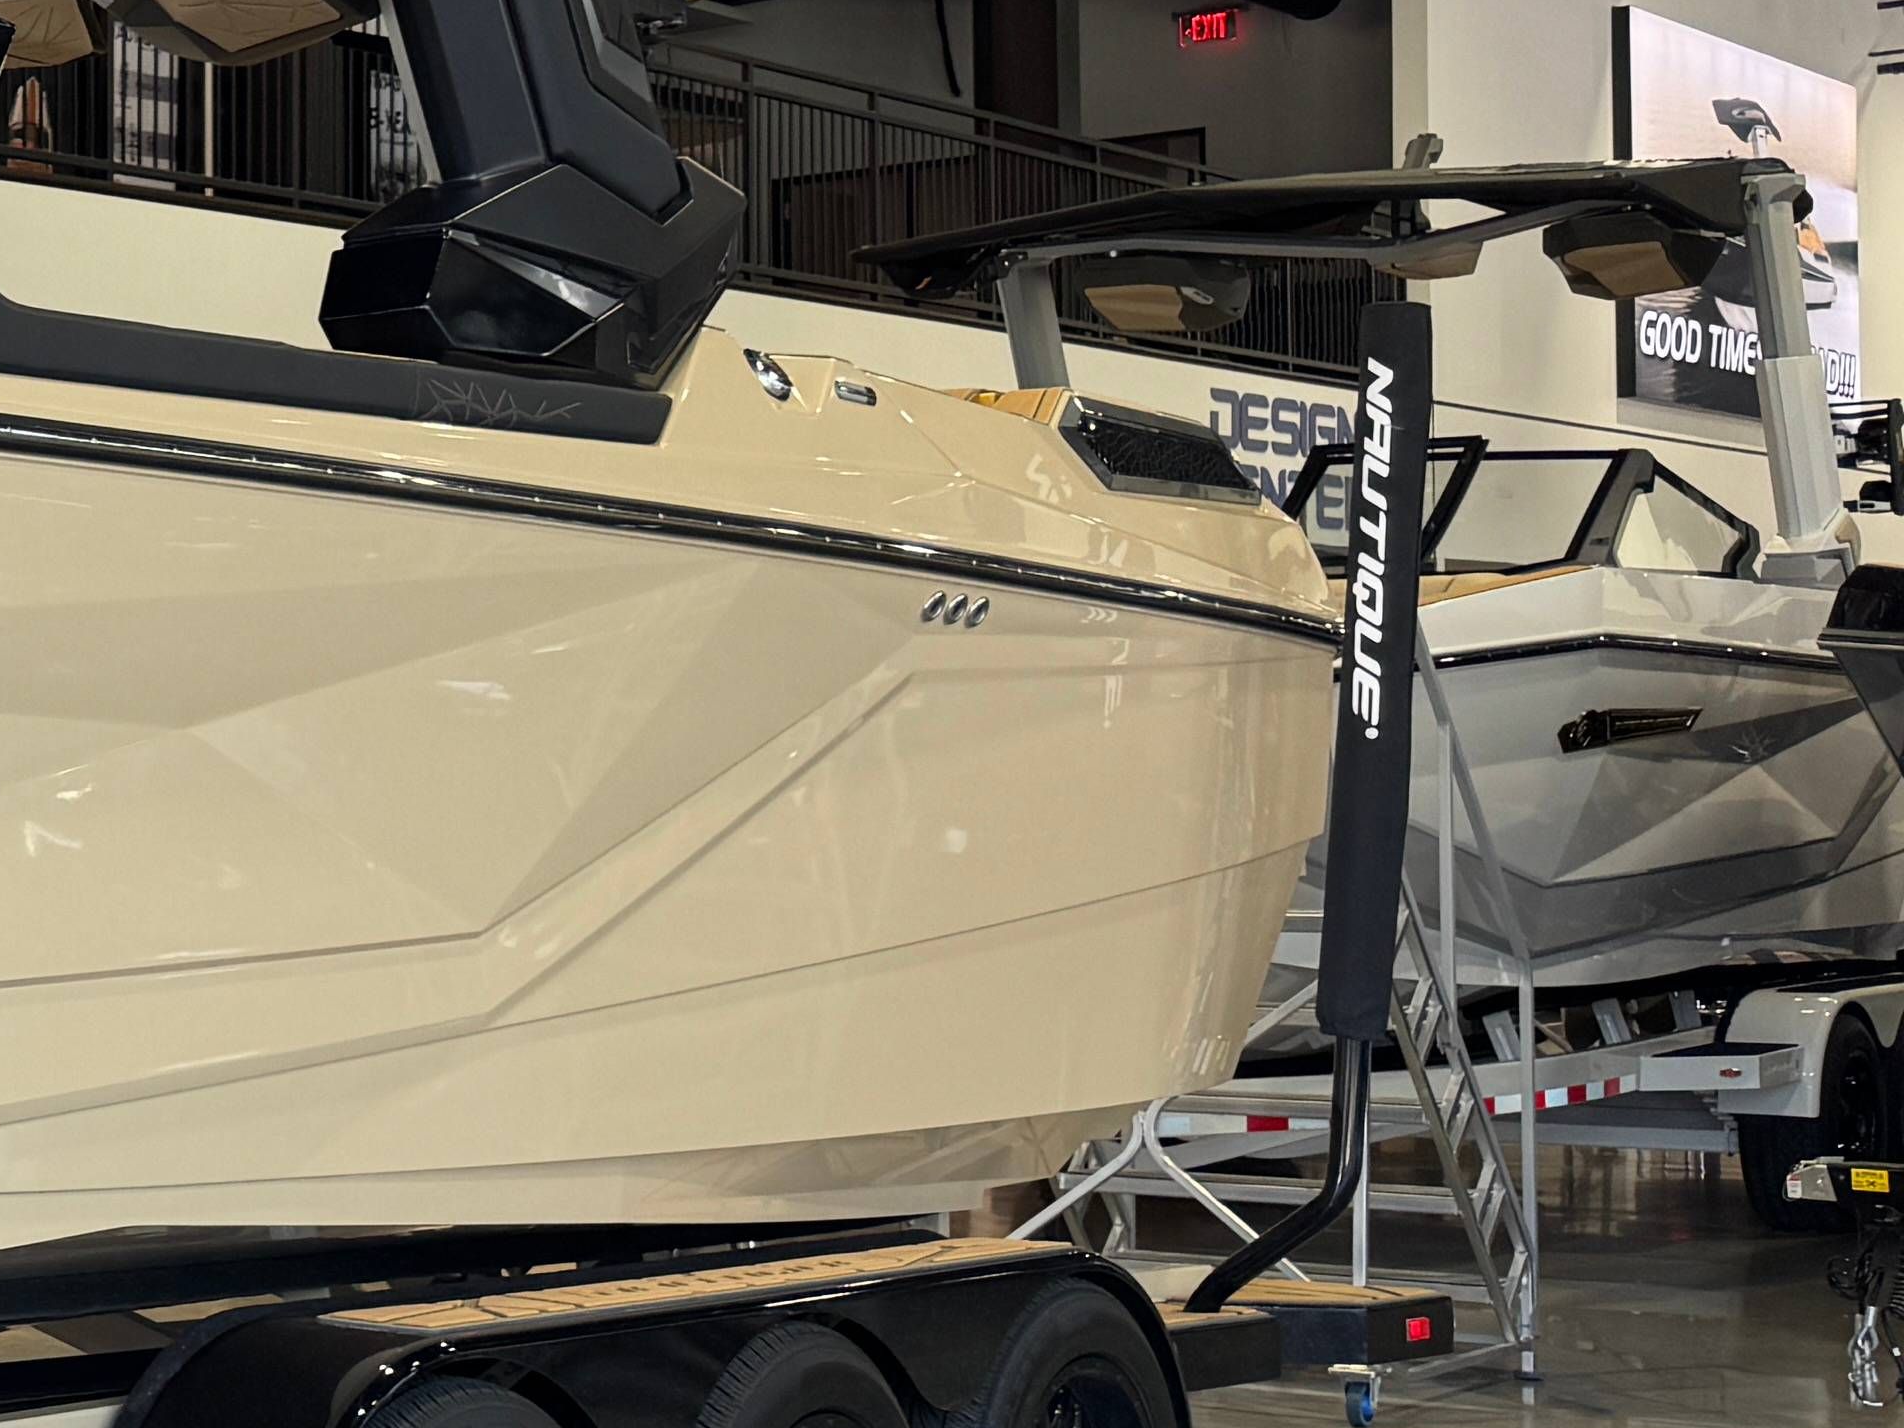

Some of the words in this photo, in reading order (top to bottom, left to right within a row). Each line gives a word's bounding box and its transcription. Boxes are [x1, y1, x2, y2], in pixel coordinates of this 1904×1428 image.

[1191, 12, 1226, 41] EXIT
[1639, 310, 1703, 364] GOOD
[1350, 356, 1394, 729] NAUTIQUE
